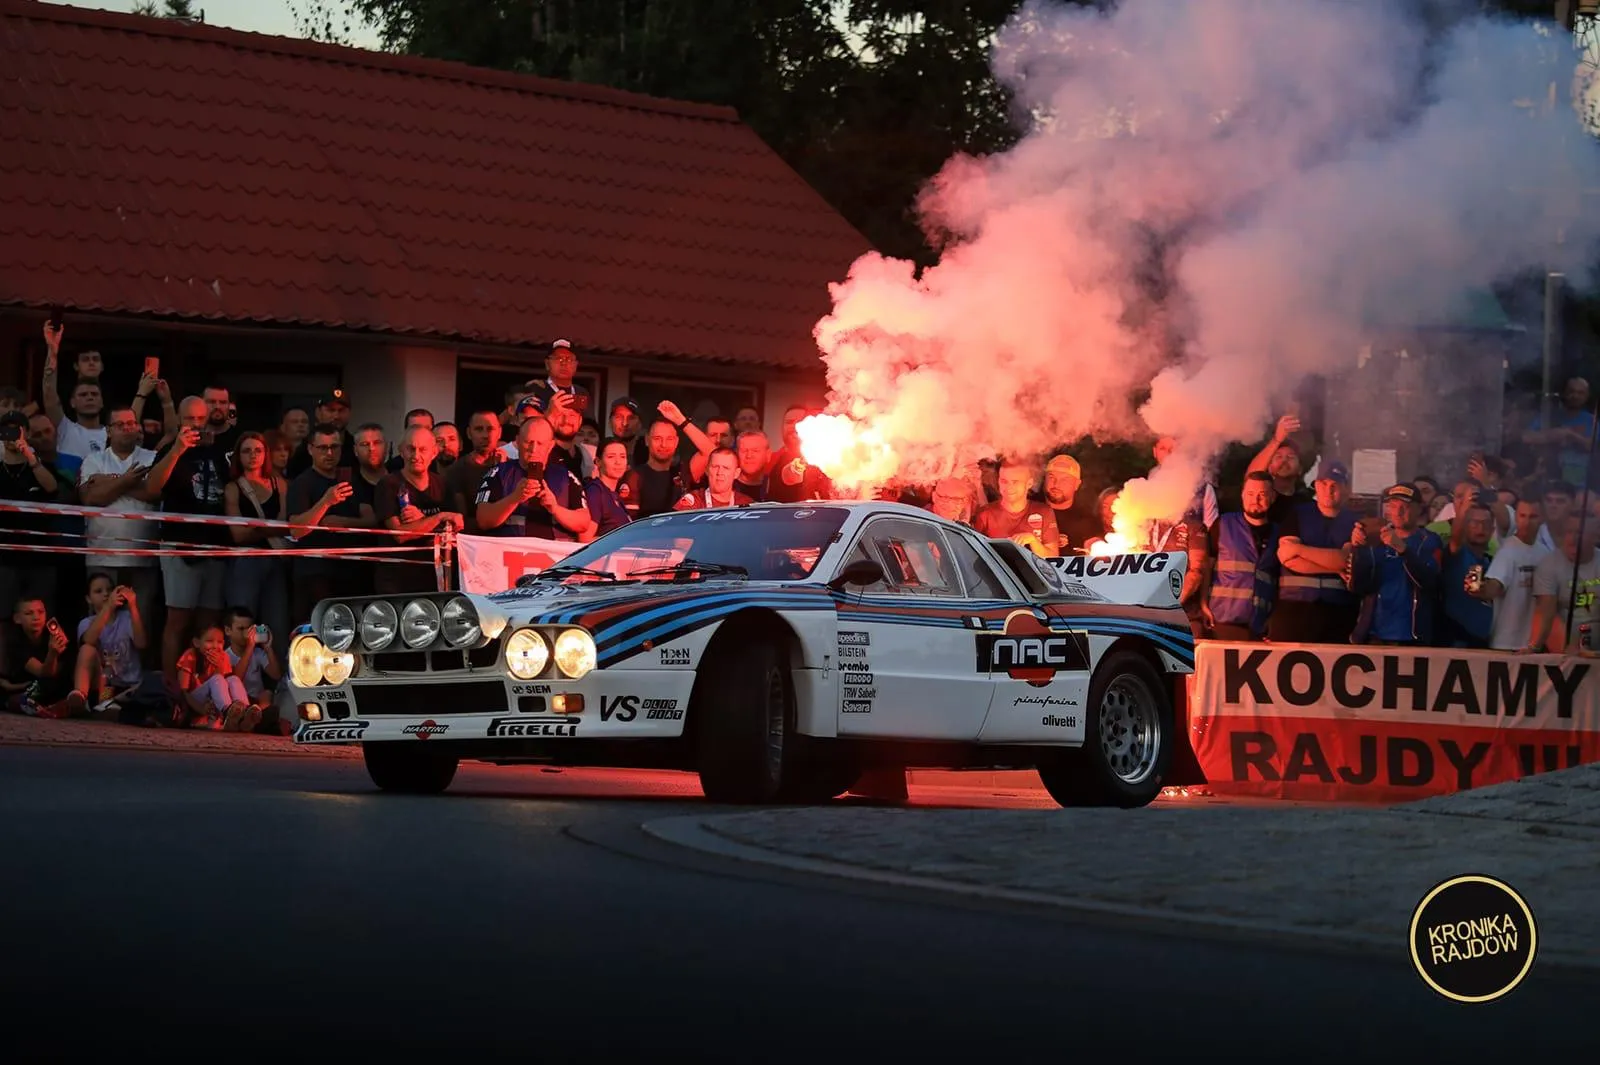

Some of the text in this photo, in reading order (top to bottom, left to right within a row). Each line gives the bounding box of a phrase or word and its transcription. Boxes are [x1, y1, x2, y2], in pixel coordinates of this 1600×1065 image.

[689, 510, 770, 522] NAC
[838, 647, 866, 657] BILSTEIN
[993, 638, 1067, 665] NAC
[838, 661, 869, 671] brembo
[845, 674, 872, 684] FERODO
[1224, 648, 1590, 719] KOCHAMY
[326, 690, 347, 700] SIEM
[526, 685, 551, 694] SIEM
[844, 687, 858, 699] TRW
[600, 695, 640, 722] VS
[642, 699, 678, 710] OLIO
[843, 701, 870, 712] Savara
[646, 710, 684, 720] FIAT
[487, 717, 581, 737] PIRELLI
[1042, 715, 1076, 728] olivetti
[295, 721, 370, 742] PIRELLI
[402, 724, 450, 734] MARTINI
[1229, 730, 1492, 790] RAJDY
